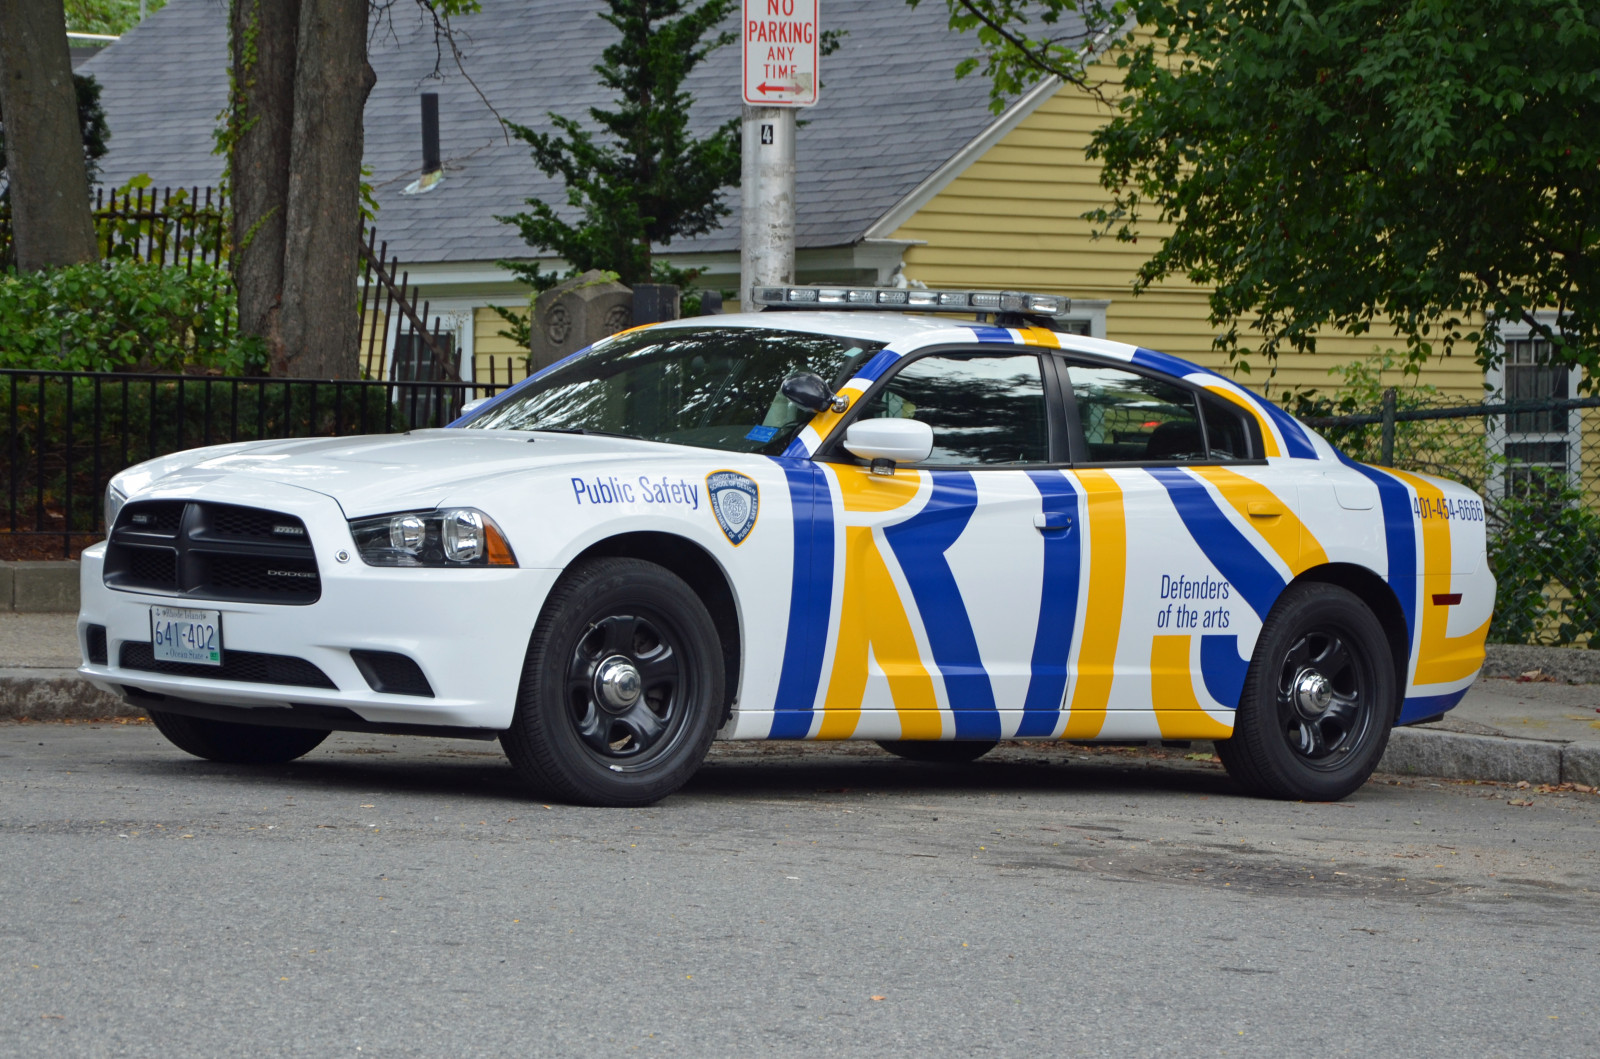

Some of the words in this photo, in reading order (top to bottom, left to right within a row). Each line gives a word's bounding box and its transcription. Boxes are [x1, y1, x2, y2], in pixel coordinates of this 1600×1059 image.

[768, 0, 794, 16] NO
[748, 21, 813, 44] PARKING
[767, 46, 795, 61] ANY
[763, 64, 798, 80] TIME
[762, 125, 772, 144] 4
[730, 473, 750, 485] ISLAND
[571, 476, 635, 505] Public
[638, 476, 699, 511] Safety
[710, 481, 729, 491] SCHOOL
[736, 481, 757, 495] DESIGN
[710, 493, 730, 532] DEPARTMENT
[728, 531, 735, 539] OF
[1413, 497, 1484, 521] 401-454-6666
[738, 521, 752, 540] PUBLIC
[750, 496, 758, 520] SAFETY
[267, 569, 316, 578] DODGE
[1160, 574, 1230, 599] Defenders
[165, 608, 183, 619] Rhode
[184, 609, 203, 620] Island
[1157, 603, 1172, 628] of
[1176, 603, 1198, 628] the
[1203, 606, 1230, 628] arts
[170, 648, 187, 659] Ocean
[188, 650, 204, 660] State
